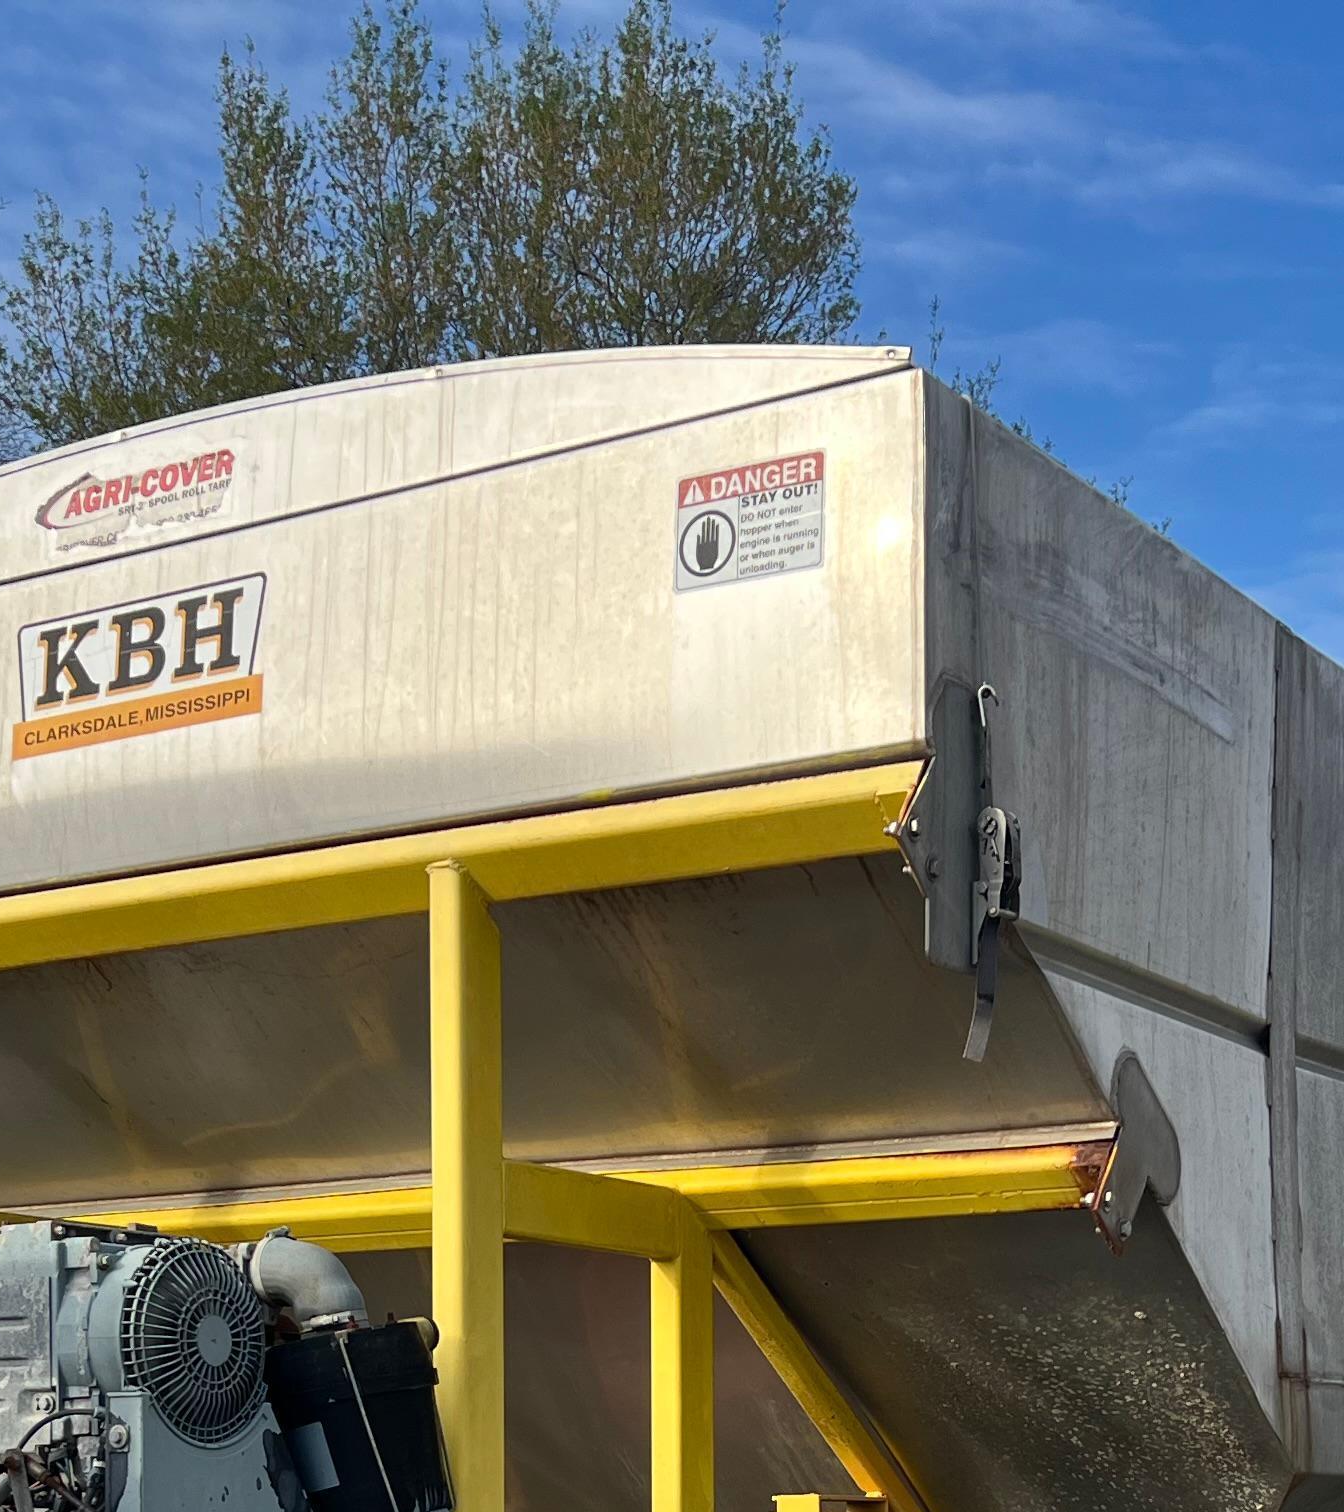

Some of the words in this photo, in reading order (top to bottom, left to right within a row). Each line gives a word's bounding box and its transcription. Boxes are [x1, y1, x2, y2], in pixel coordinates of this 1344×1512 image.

[63, 448, 235, 519] AGRI-COVER
[710, 457, 817, 500] DANGER
[148, 494, 180, 508] SPOOL
[182, 487, 206, 499] ROLL
[741, 490, 777, 508] STAY
[782, 483, 818, 500] OUT!
[740, 512, 755, 523] DO
[757, 508, 776, 520] NOT
[778, 504, 803, 515] enter
[739, 537, 770, 549] engine
[773, 533, 781, 543] is
[783, 528, 819, 540] running
[740, 524, 772, 536] hopper
[774, 519, 799, 529] when
[739, 554, 749, 562] or
[751, 549, 776, 559] when
[778, 543, 805, 555] auger
[807, 541, 815, 550] is
[33, 587, 244, 711] KBH
[24, 710, 143, 746] CLARKSDALE,
[145, 688, 250, 722] MISSISSIPPI
